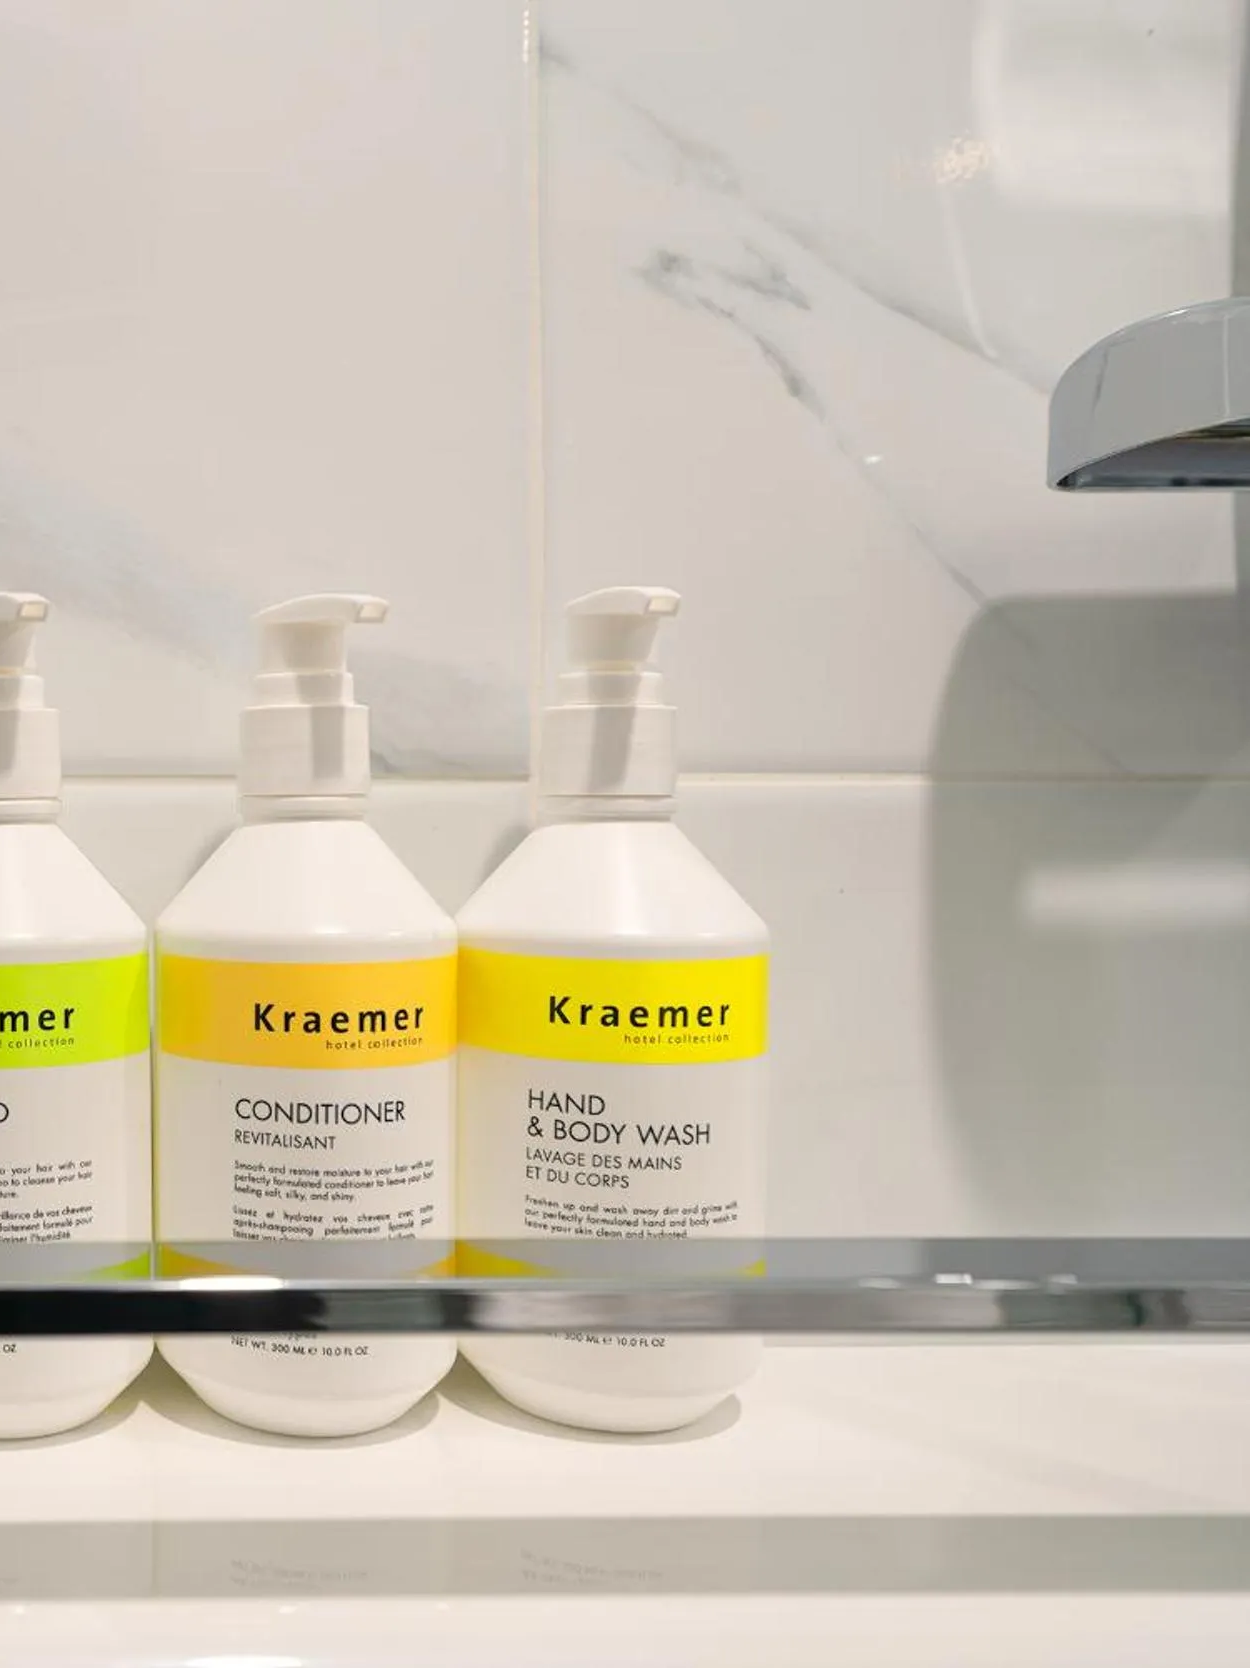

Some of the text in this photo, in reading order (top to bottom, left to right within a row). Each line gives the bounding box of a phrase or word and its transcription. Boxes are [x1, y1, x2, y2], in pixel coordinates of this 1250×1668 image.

[254, 1003, 424, 1033] Kraemer
[549, 996, 730, 1028] Kraemer
[8, 1037, 75, 1049] collection
[326, 1037, 423, 1049] hotel collection
[624, 1033, 730, 1044] hotel collection
[235, 1098, 406, 1125] CONDITIONER
[528, 1088, 606, 1116] HAND
[234, 1128, 336, 1149] REVITALISANT
[527, 1115, 711, 1146] & BODY WASH
[526, 1147, 682, 1171] LAVAGE DES MAINS
[526, 1166, 630, 1189] ET DU CORPS
[231, 1335, 248, 1347] NET
[272, 1343, 289, 1353] 300
[293, 1345, 306, 1355] ML
[344, 1347, 352, 1355] FL
[355, 1346, 369, 1355] OZ
